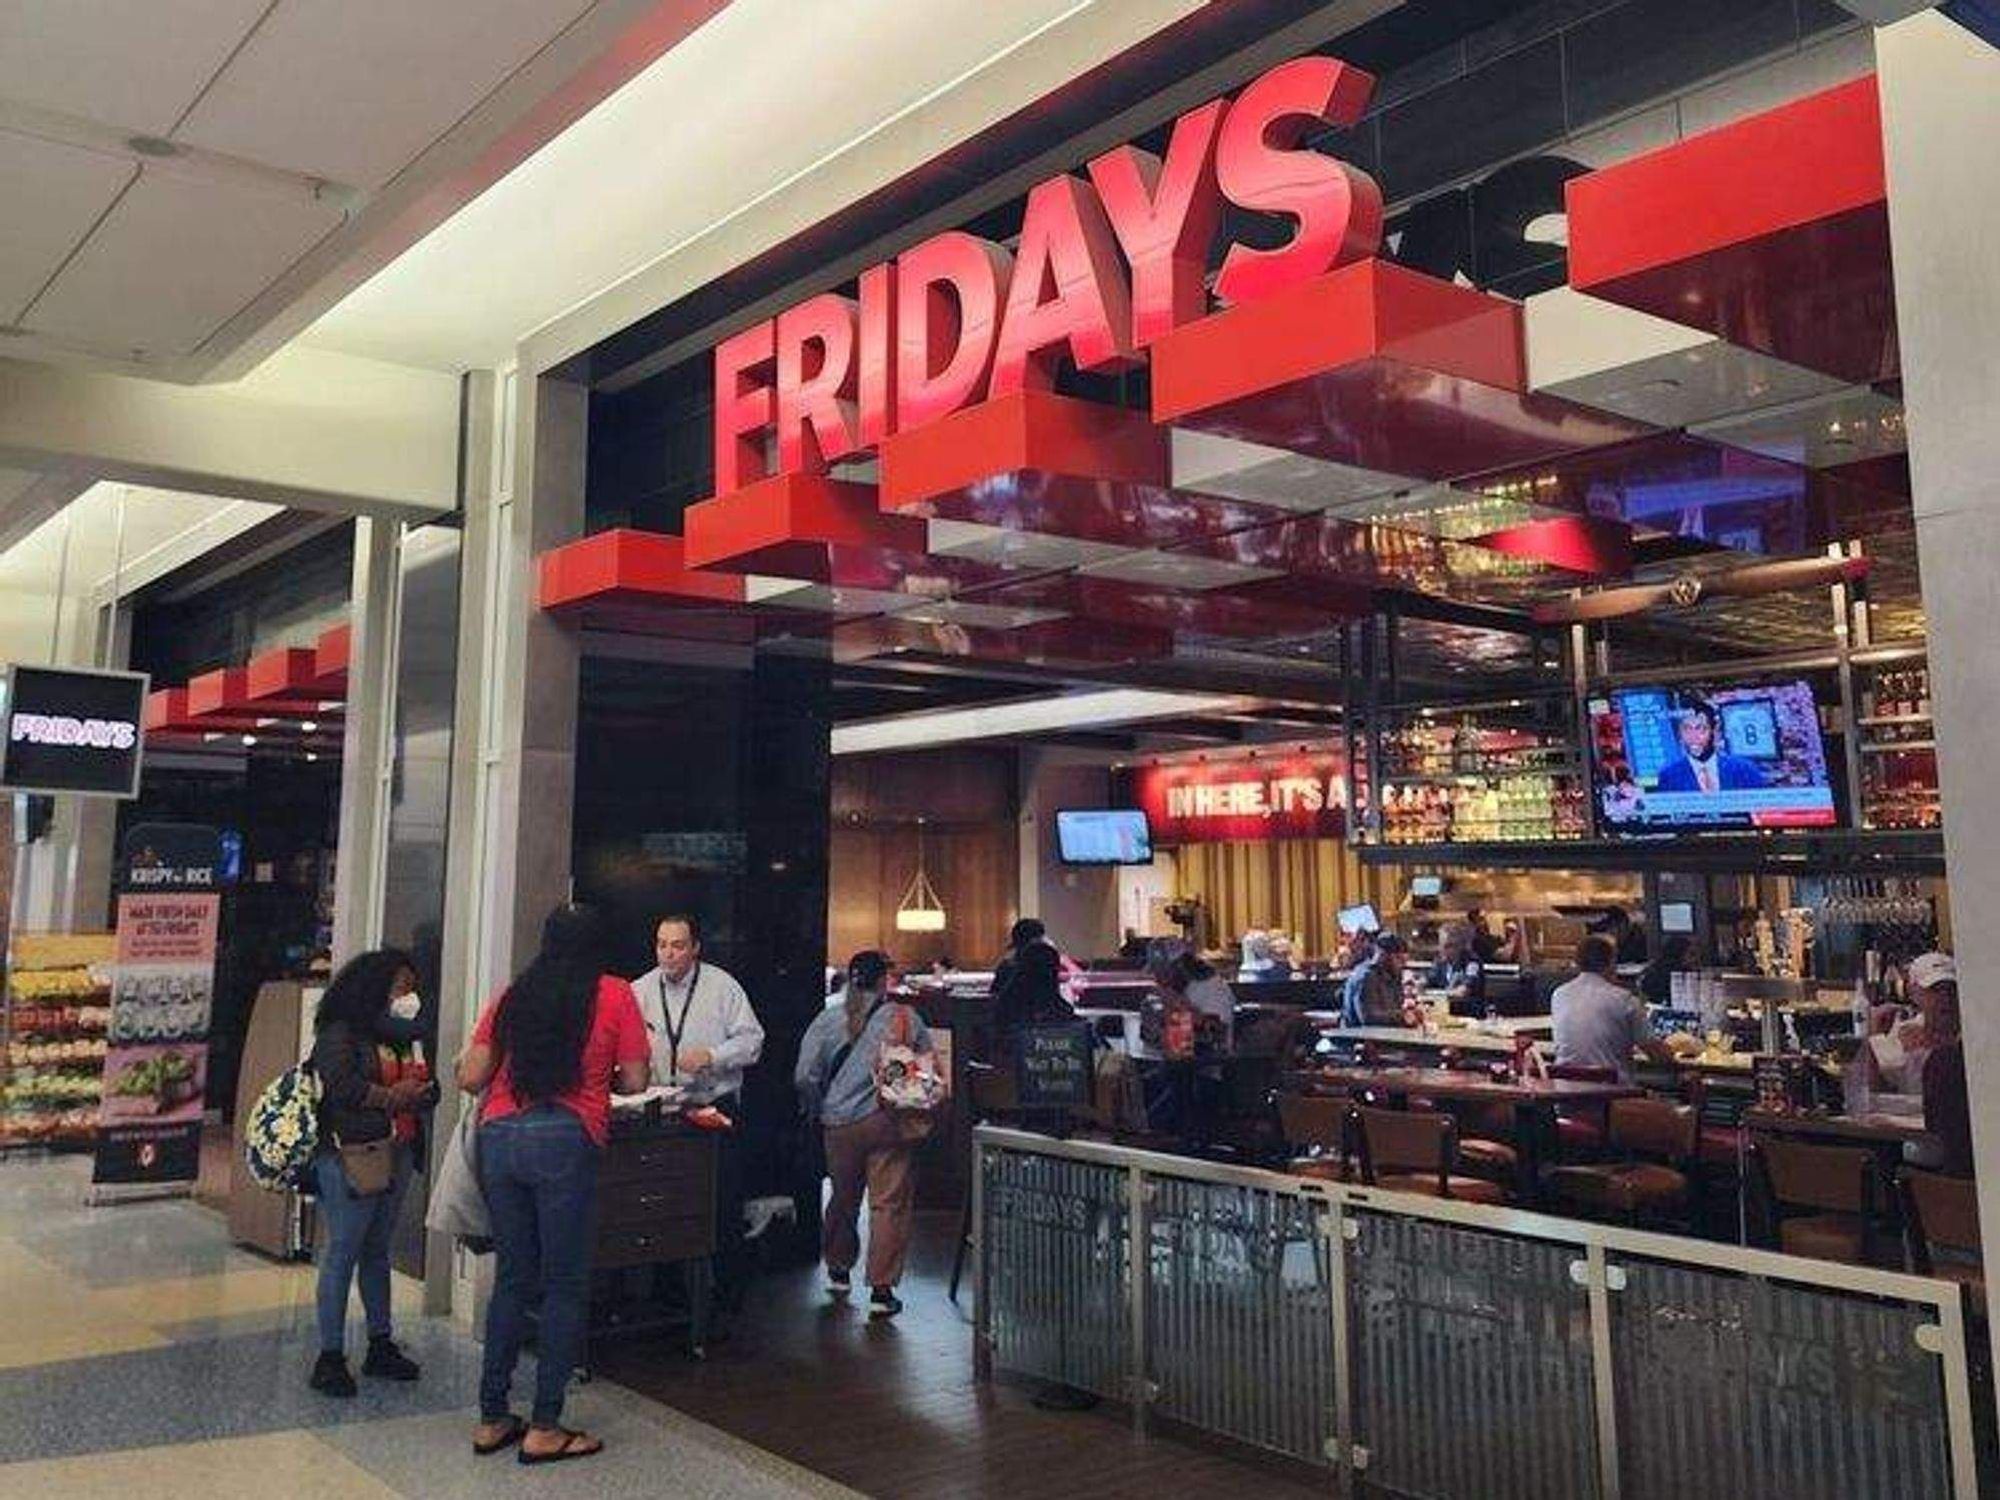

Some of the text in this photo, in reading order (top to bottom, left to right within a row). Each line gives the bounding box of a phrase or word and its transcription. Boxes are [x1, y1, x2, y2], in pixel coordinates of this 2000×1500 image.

[714, 54, 1375, 499] FRIDAYS
[11, 713, 136, 749] FRIDAYS
[1270, 776, 1324, 813] IT'S
[130, 866, 174, 884] KRISPY
[186, 866, 214, 886] RICE
[1001, 1187, 1087, 1231] FRIDAYS
